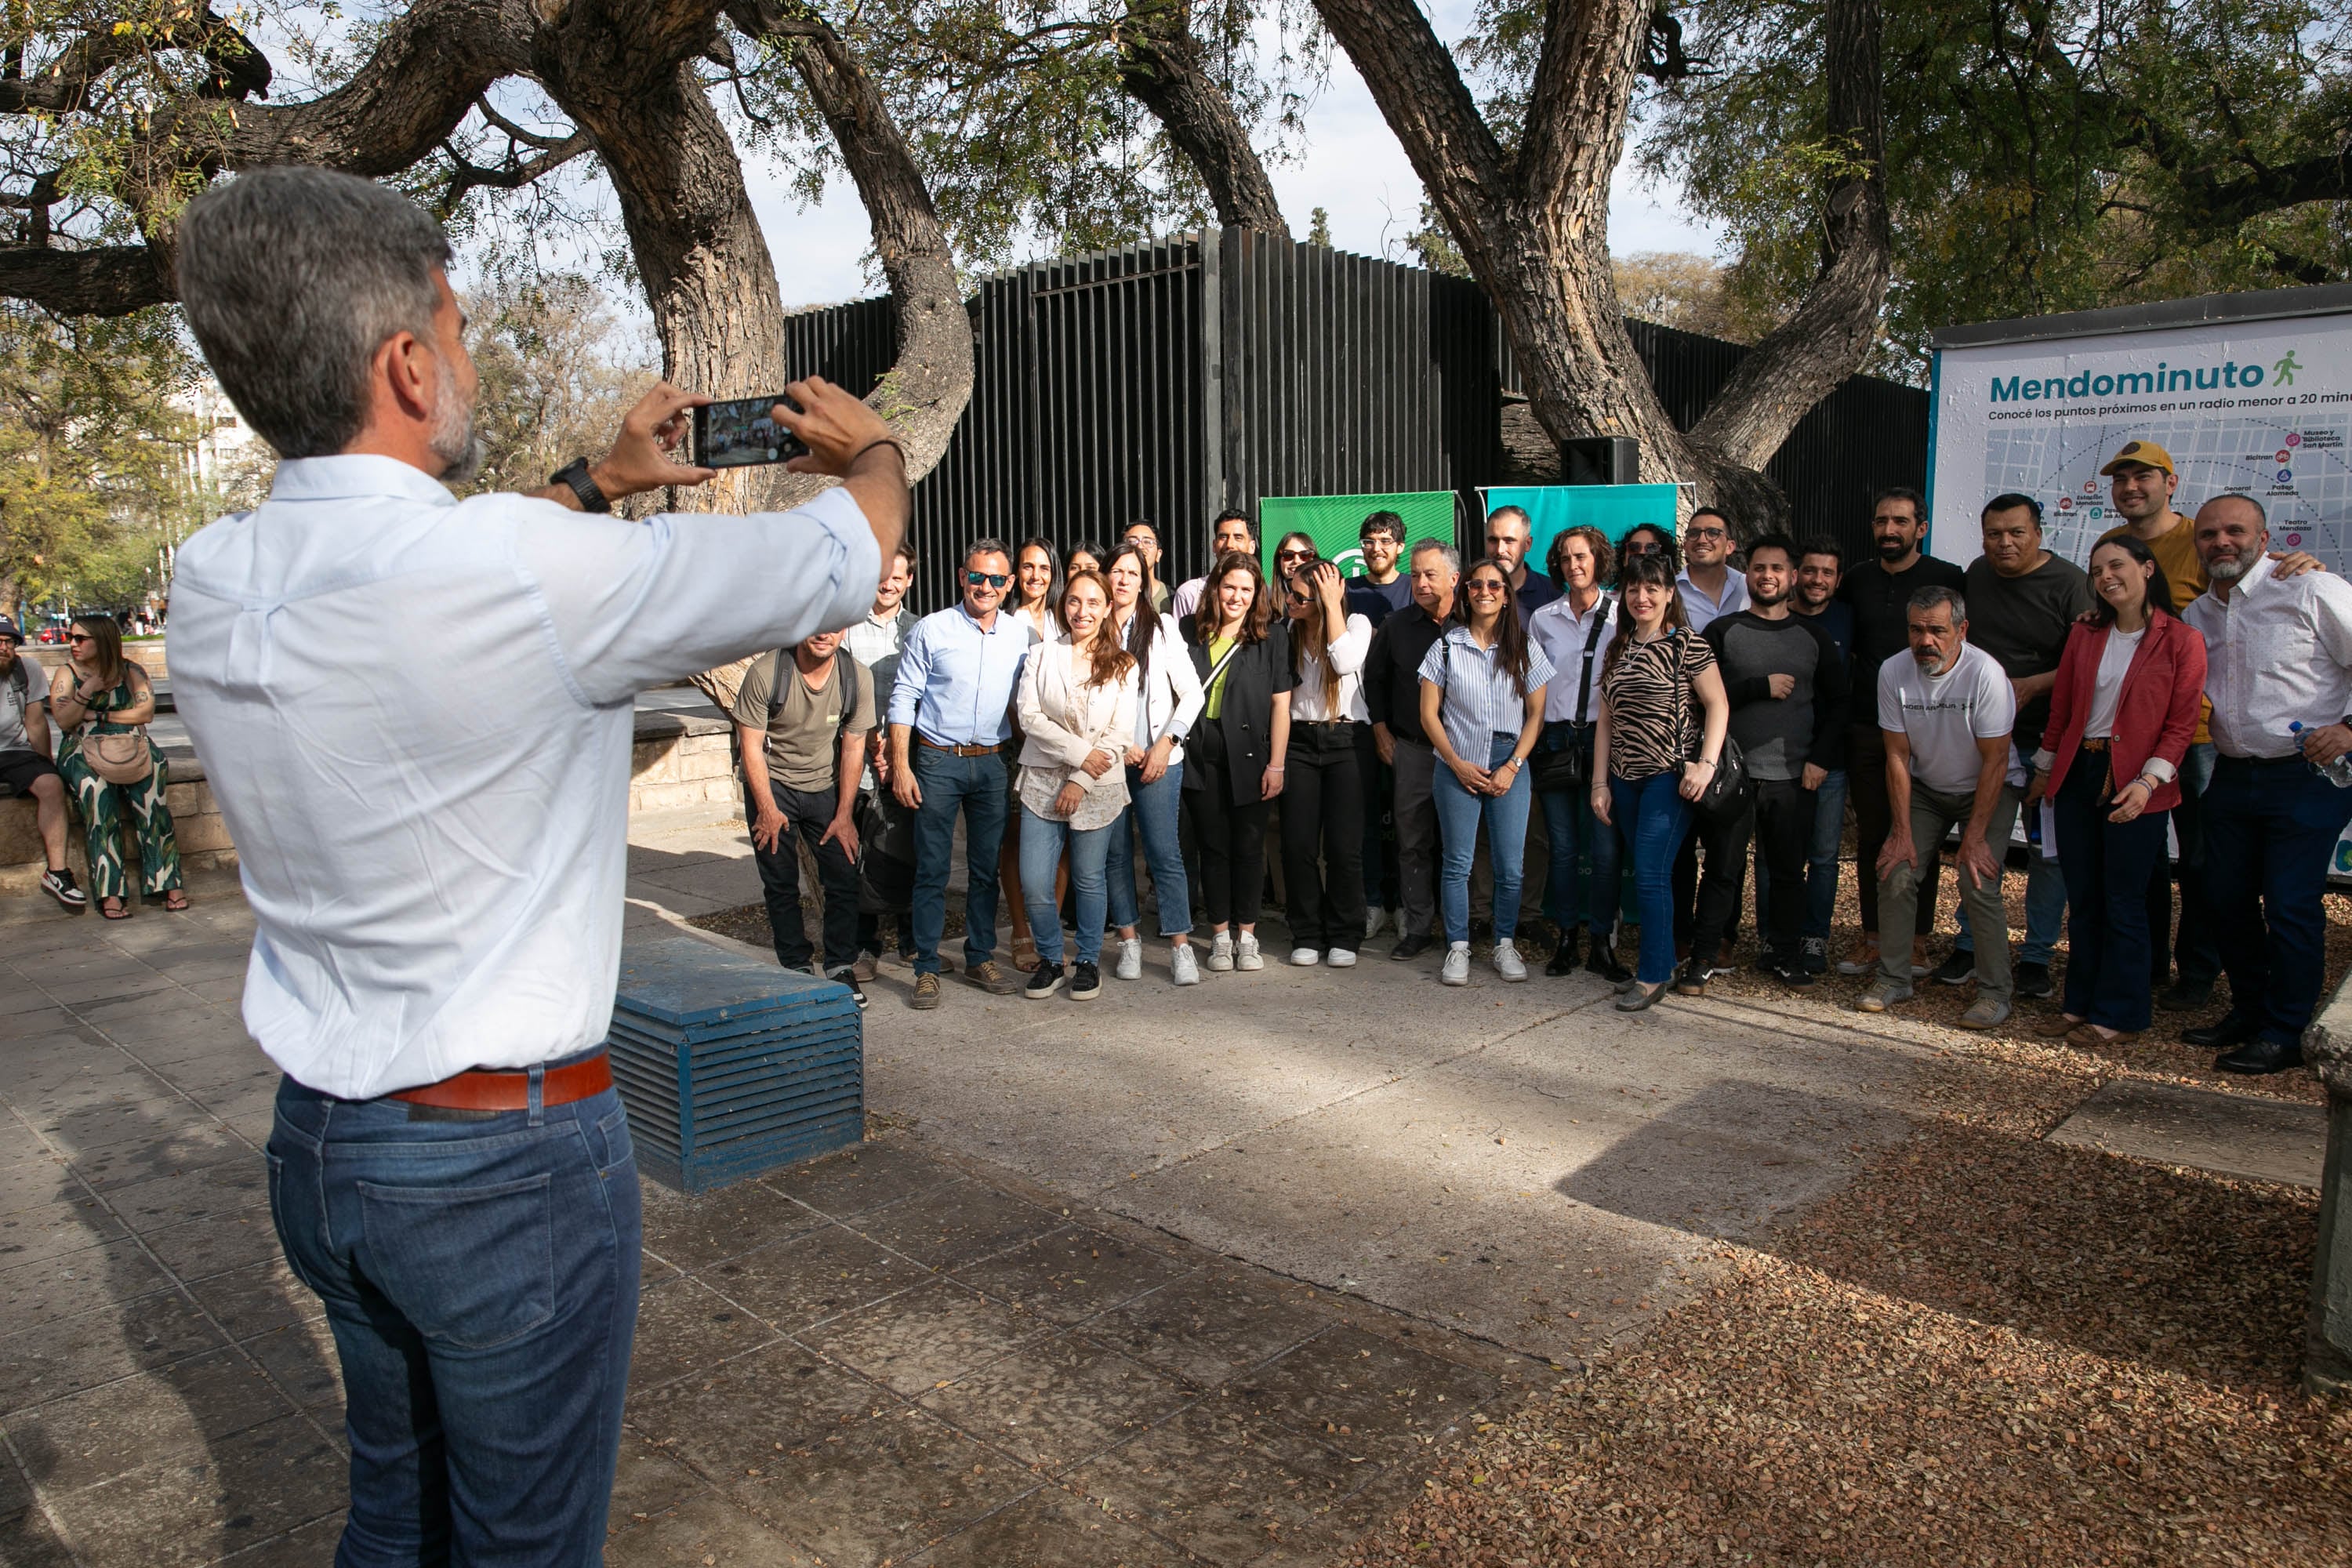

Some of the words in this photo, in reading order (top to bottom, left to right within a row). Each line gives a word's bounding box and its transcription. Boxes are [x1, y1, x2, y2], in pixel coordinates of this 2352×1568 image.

[1991, 361, 2264, 403] Mendominuto
[1988, 408, 2032, 420] Conocé
[2035, 408, 2052, 418] los
[2054, 405, 2096, 419] puntos
[2099, 403, 2157, 417] próximos
[2160, 402, 2176, 412] en
[2180, 401, 2196, 410] un
[2199, 397, 2234, 409] radio
[2238, 396, 2285, 407] menor
[2287, 396, 2296, 405] a
[2299, 393, 2318, 405] 20
[2321, 391, 2352, 404] min
